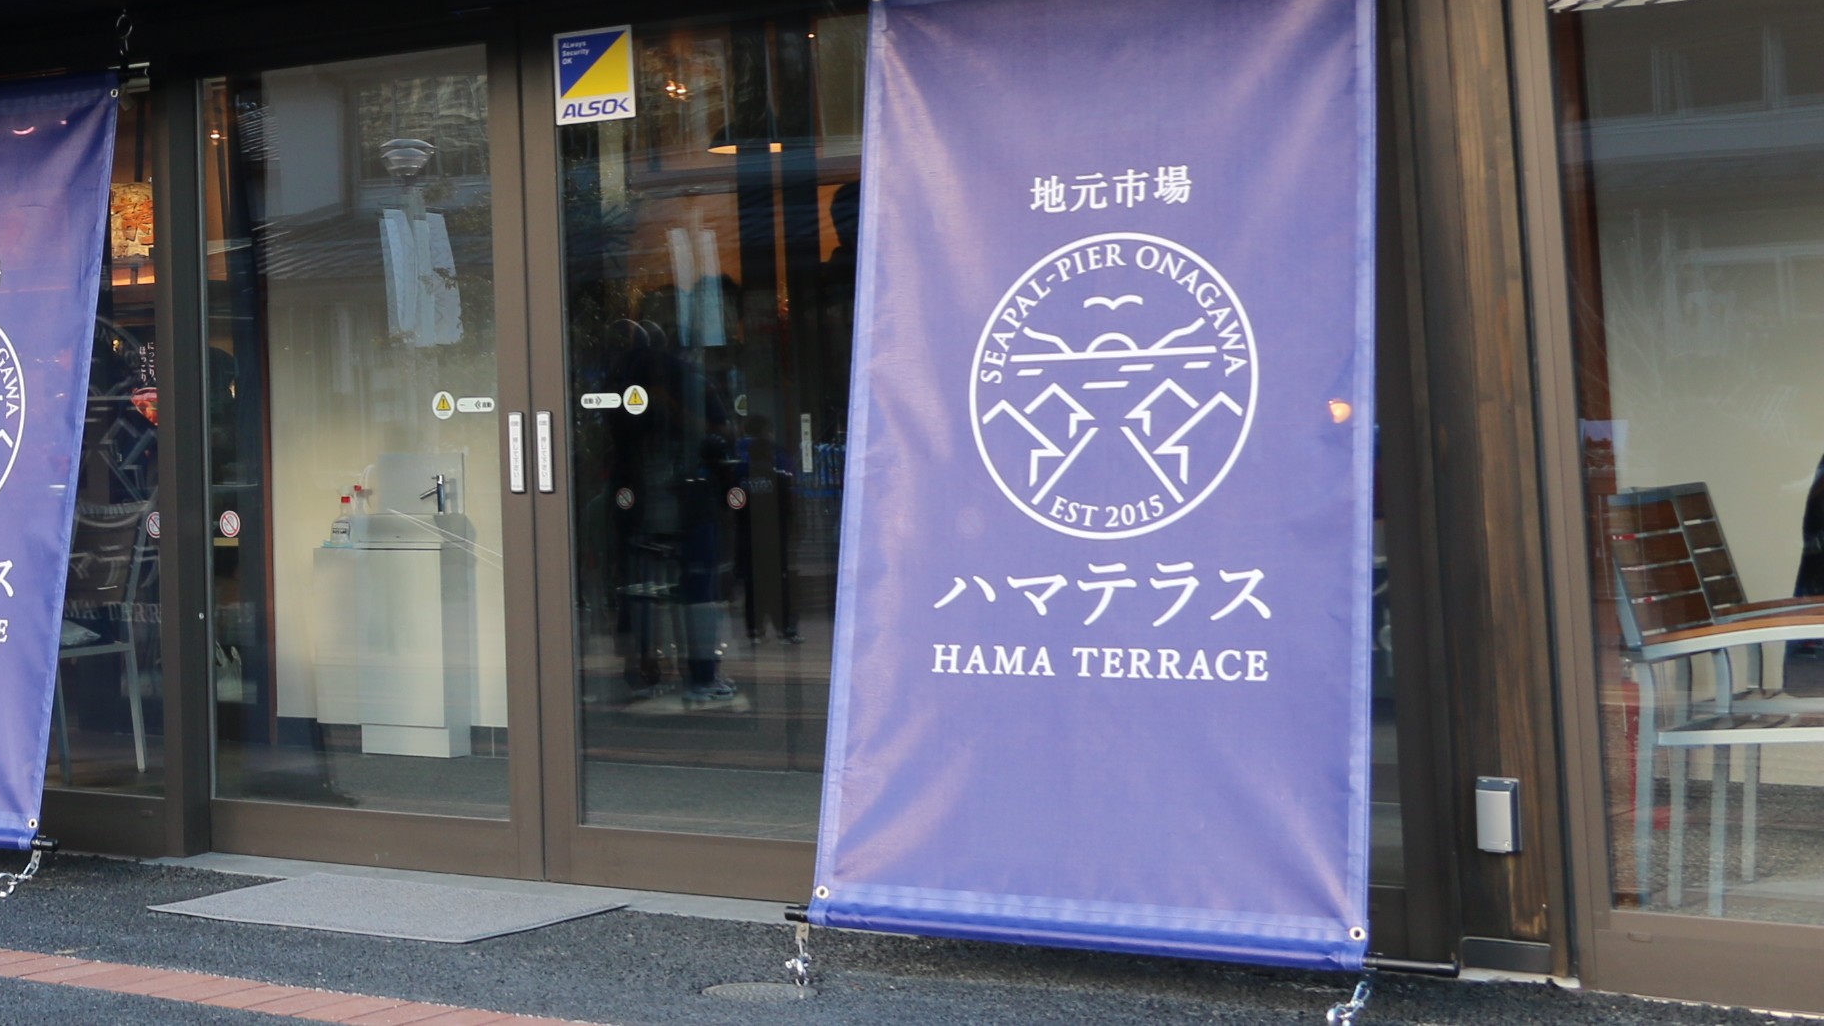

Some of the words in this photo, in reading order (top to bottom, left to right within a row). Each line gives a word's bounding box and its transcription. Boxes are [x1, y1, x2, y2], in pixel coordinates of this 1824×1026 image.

[561, 48, 590, 57] Security
[561, 57, 573, 65] OK
[562, 97, 630, 119] ALSOK
[1030, 165, 1192, 213] 地元市場
[980, 243, 1126, 384] SEAPAL-PIER
[1136, 245, 1247, 377] ONAGAWA
[1049, 495, 1100, 528] EST
[1105, 495, 1165, 528] 2015
[933, 561, 1271, 627] ハマテラス
[931, 644, 1056, 676] HAMA
[1072, 647, 1269, 681] TERRACE
